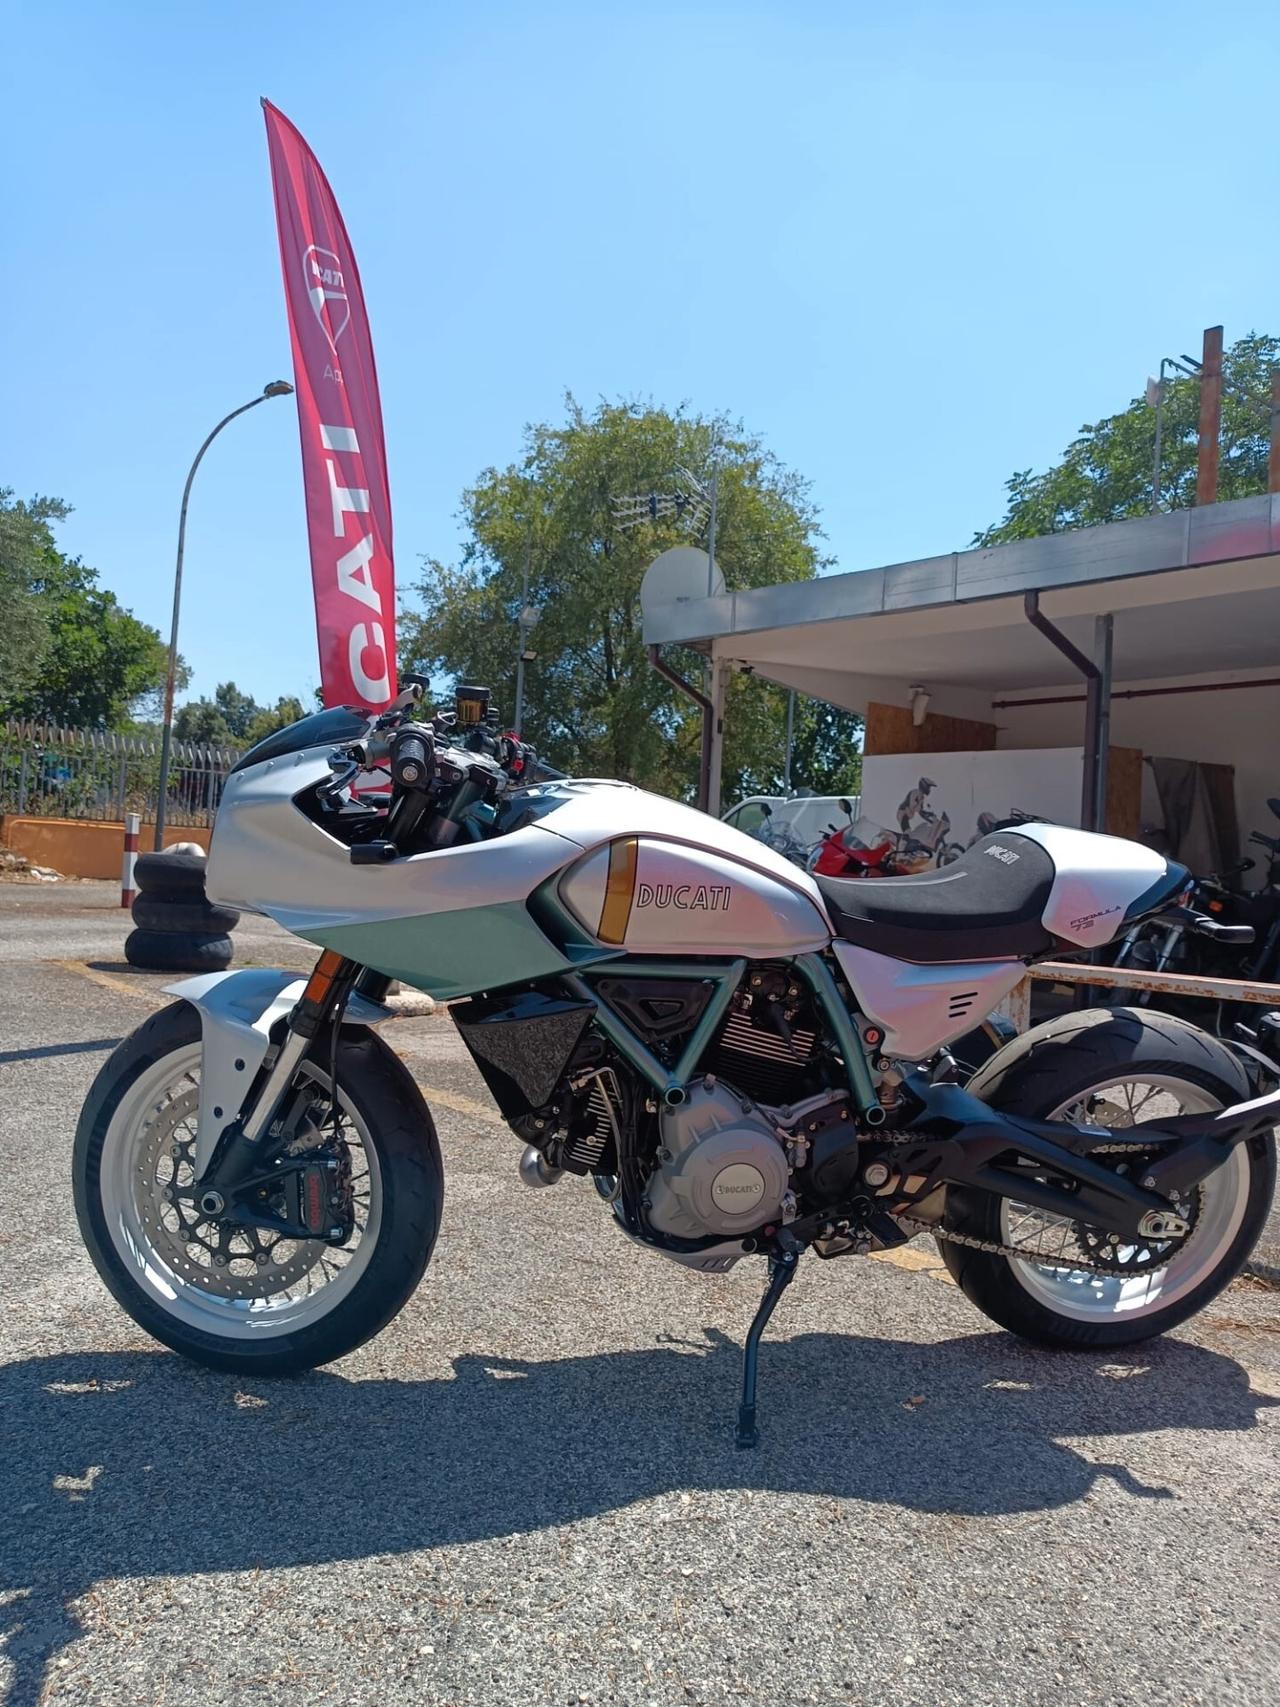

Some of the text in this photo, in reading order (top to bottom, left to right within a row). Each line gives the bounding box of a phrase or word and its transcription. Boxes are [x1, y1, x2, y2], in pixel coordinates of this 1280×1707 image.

[319, 424, 391, 704] CATI
[984, 845, 1020, 865] DUCATI
[637, 883, 731, 911] DUCATI
[1070, 905, 1121, 926] FORMULA
[307, 1174, 320, 1229] brembo
[725, 1185, 753, 1194] DUCATI
